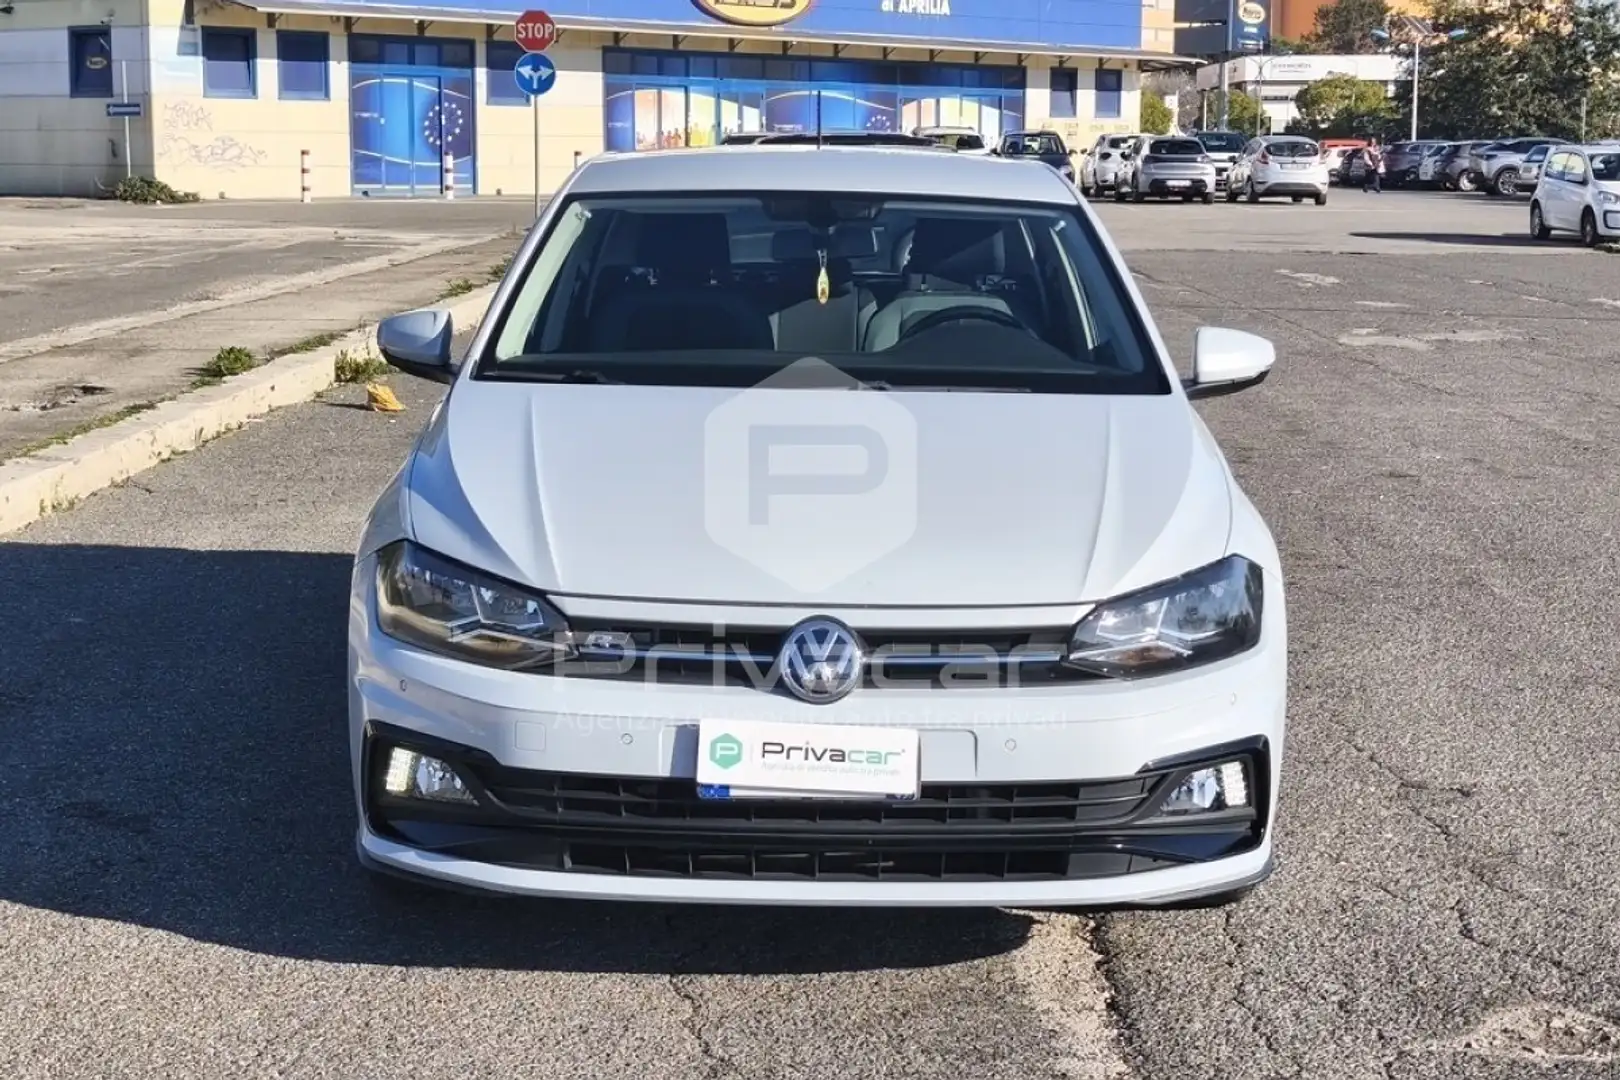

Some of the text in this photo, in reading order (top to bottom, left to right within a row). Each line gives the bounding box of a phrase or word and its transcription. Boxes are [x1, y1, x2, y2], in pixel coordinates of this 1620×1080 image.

[898, 0, 951, 16] APRILIA
[517, 22, 553, 39] STOP
[715, 743, 738, 759] P
[762, 741, 902, 765] Privacar
